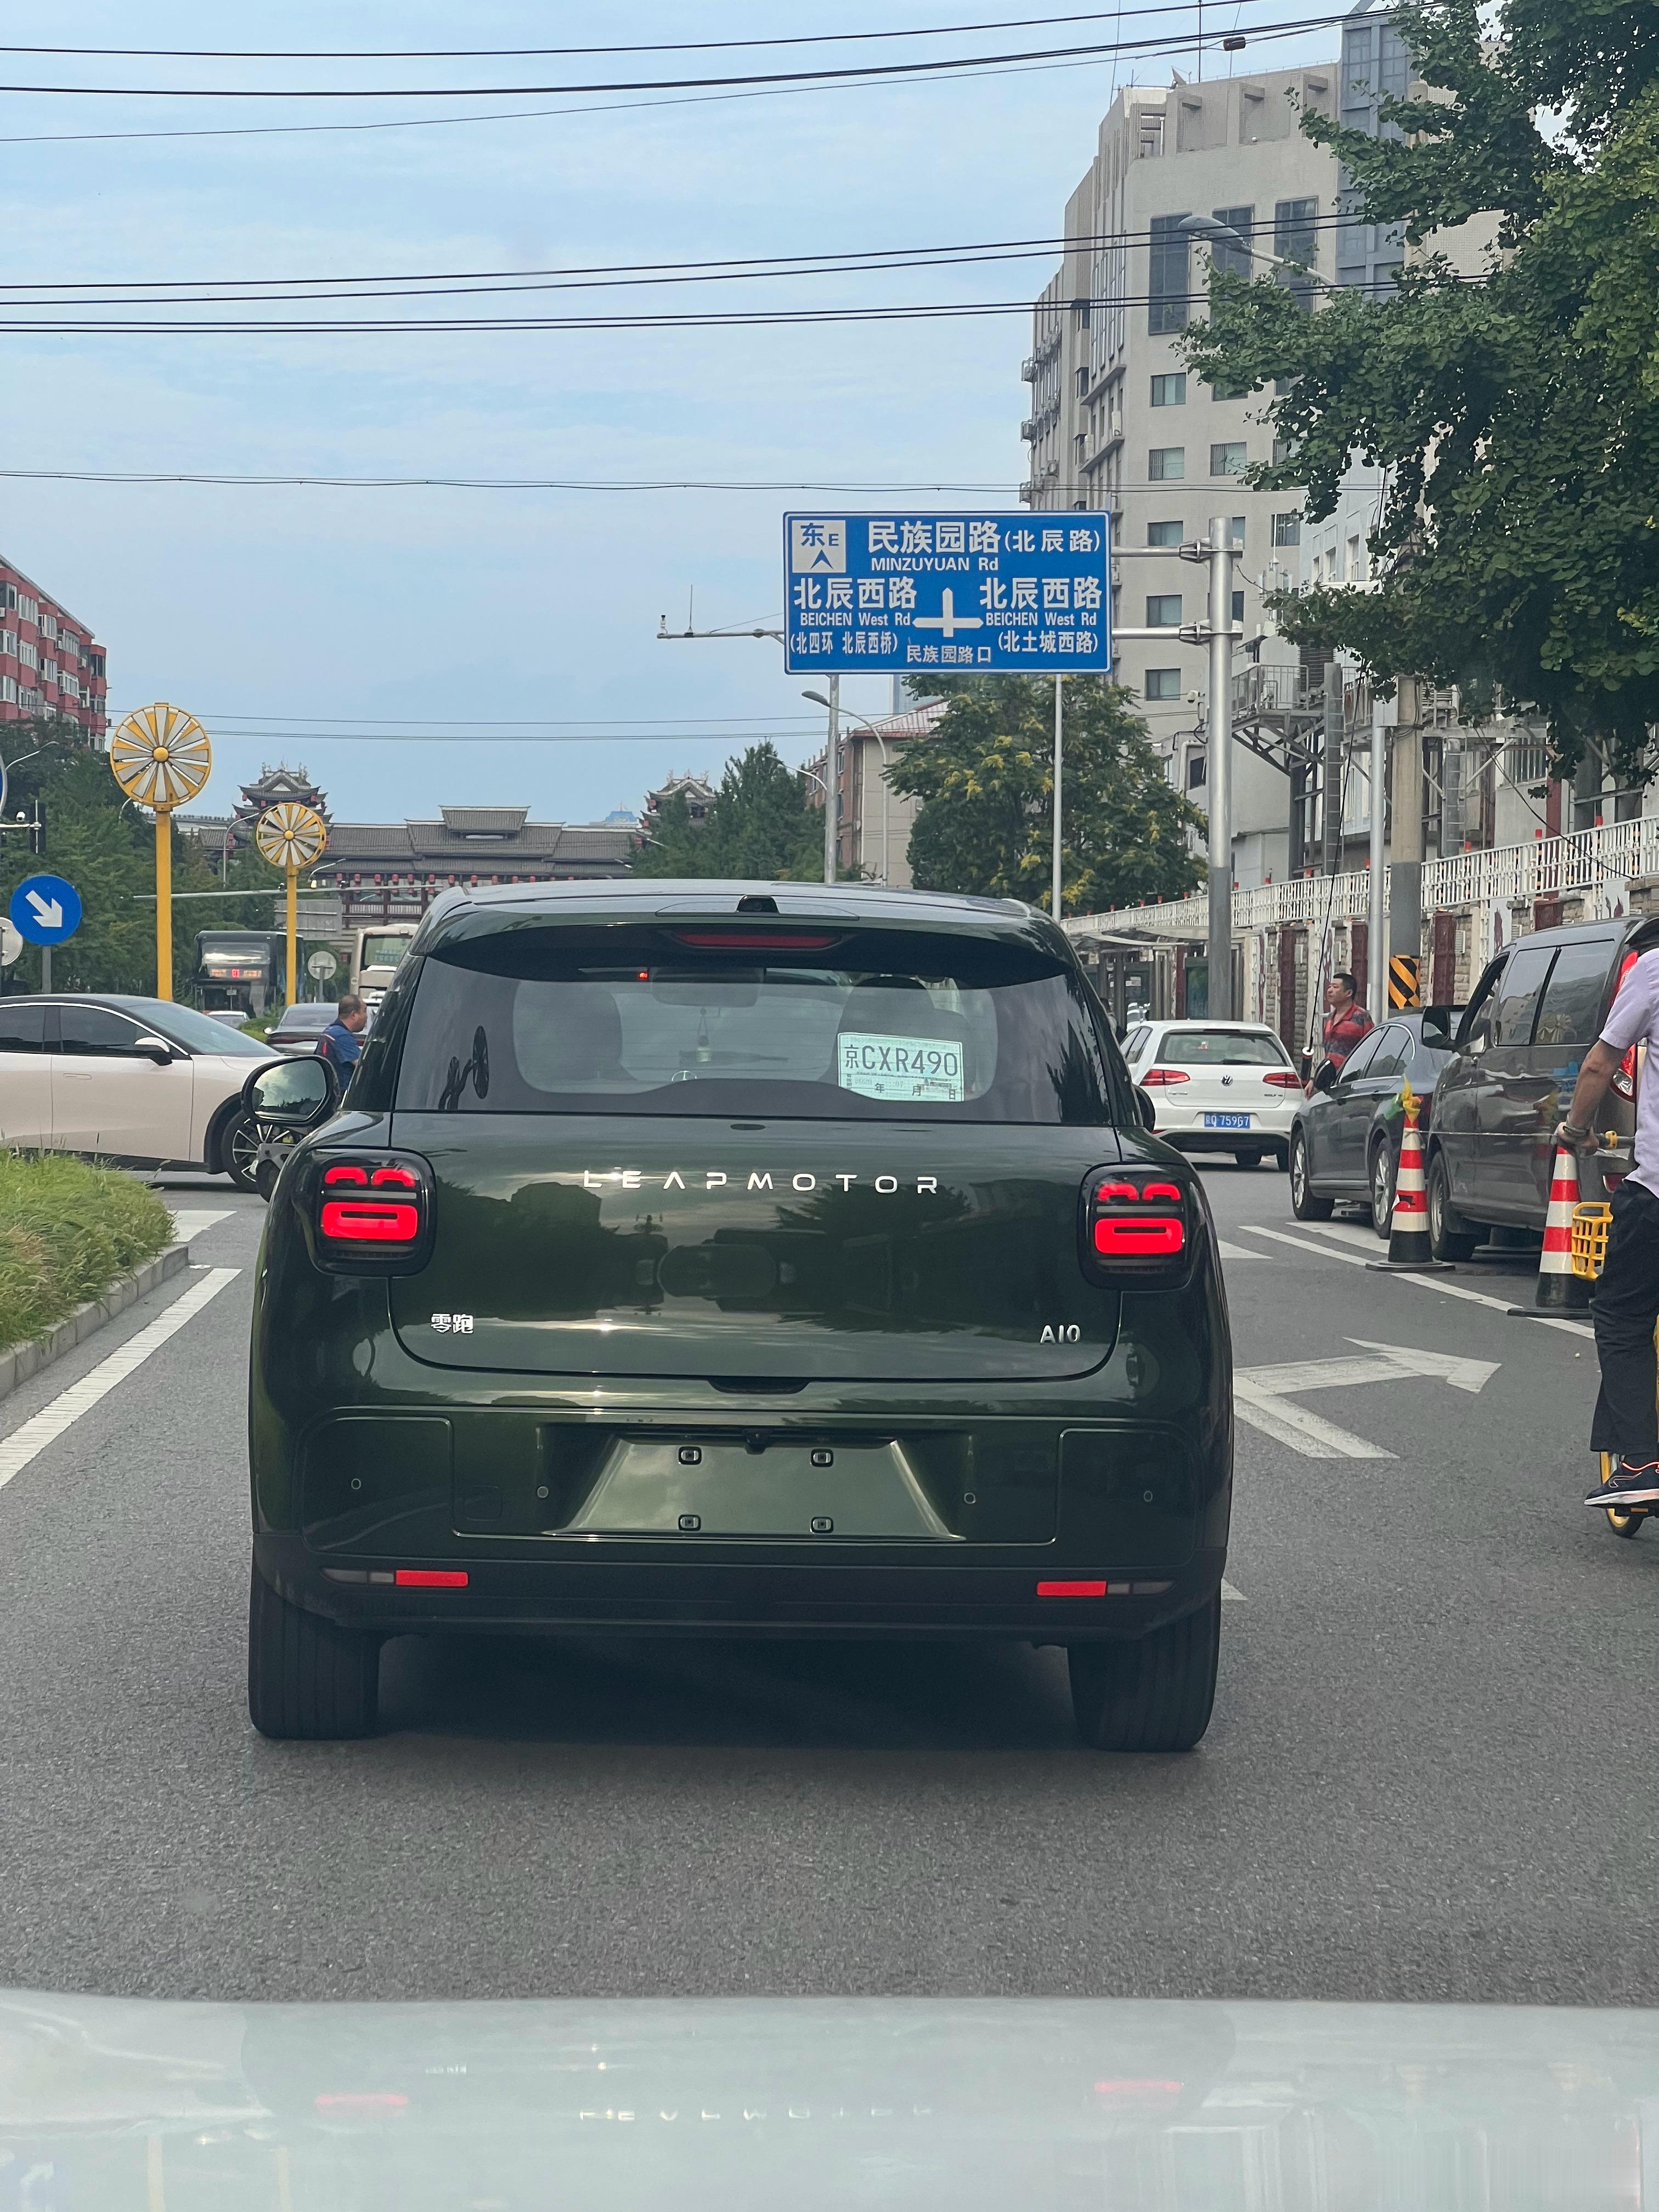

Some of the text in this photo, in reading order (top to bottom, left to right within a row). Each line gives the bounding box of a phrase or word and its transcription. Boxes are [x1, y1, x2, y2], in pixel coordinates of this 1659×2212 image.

[800, 523, 839, 546] 东 E
[868, 521, 1100, 554] 民族园路 (北辰路)
[871, 557, 999, 571] MINZUYUAN Rd
[794, 576, 917, 610] 北辰西路
[979, 576, 1102, 610] 北辰西路
[800, 612, 911, 626] BEICHEN West Rd
[986, 612, 1097, 626] BEICHEN West Rd
[998, 630, 1098, 653] (北土城西路)
[907, 645, 991, 663] 民族园路口
[844, 1044, 958, 1076] 京CXR490
[874, 1083, 884, 1093] 年
[912, 1086, 921, 1096] 月
[584, 1170, 938, 1194] LEAPMOTOR
[431, 1313, 474, 1334] 零跑
